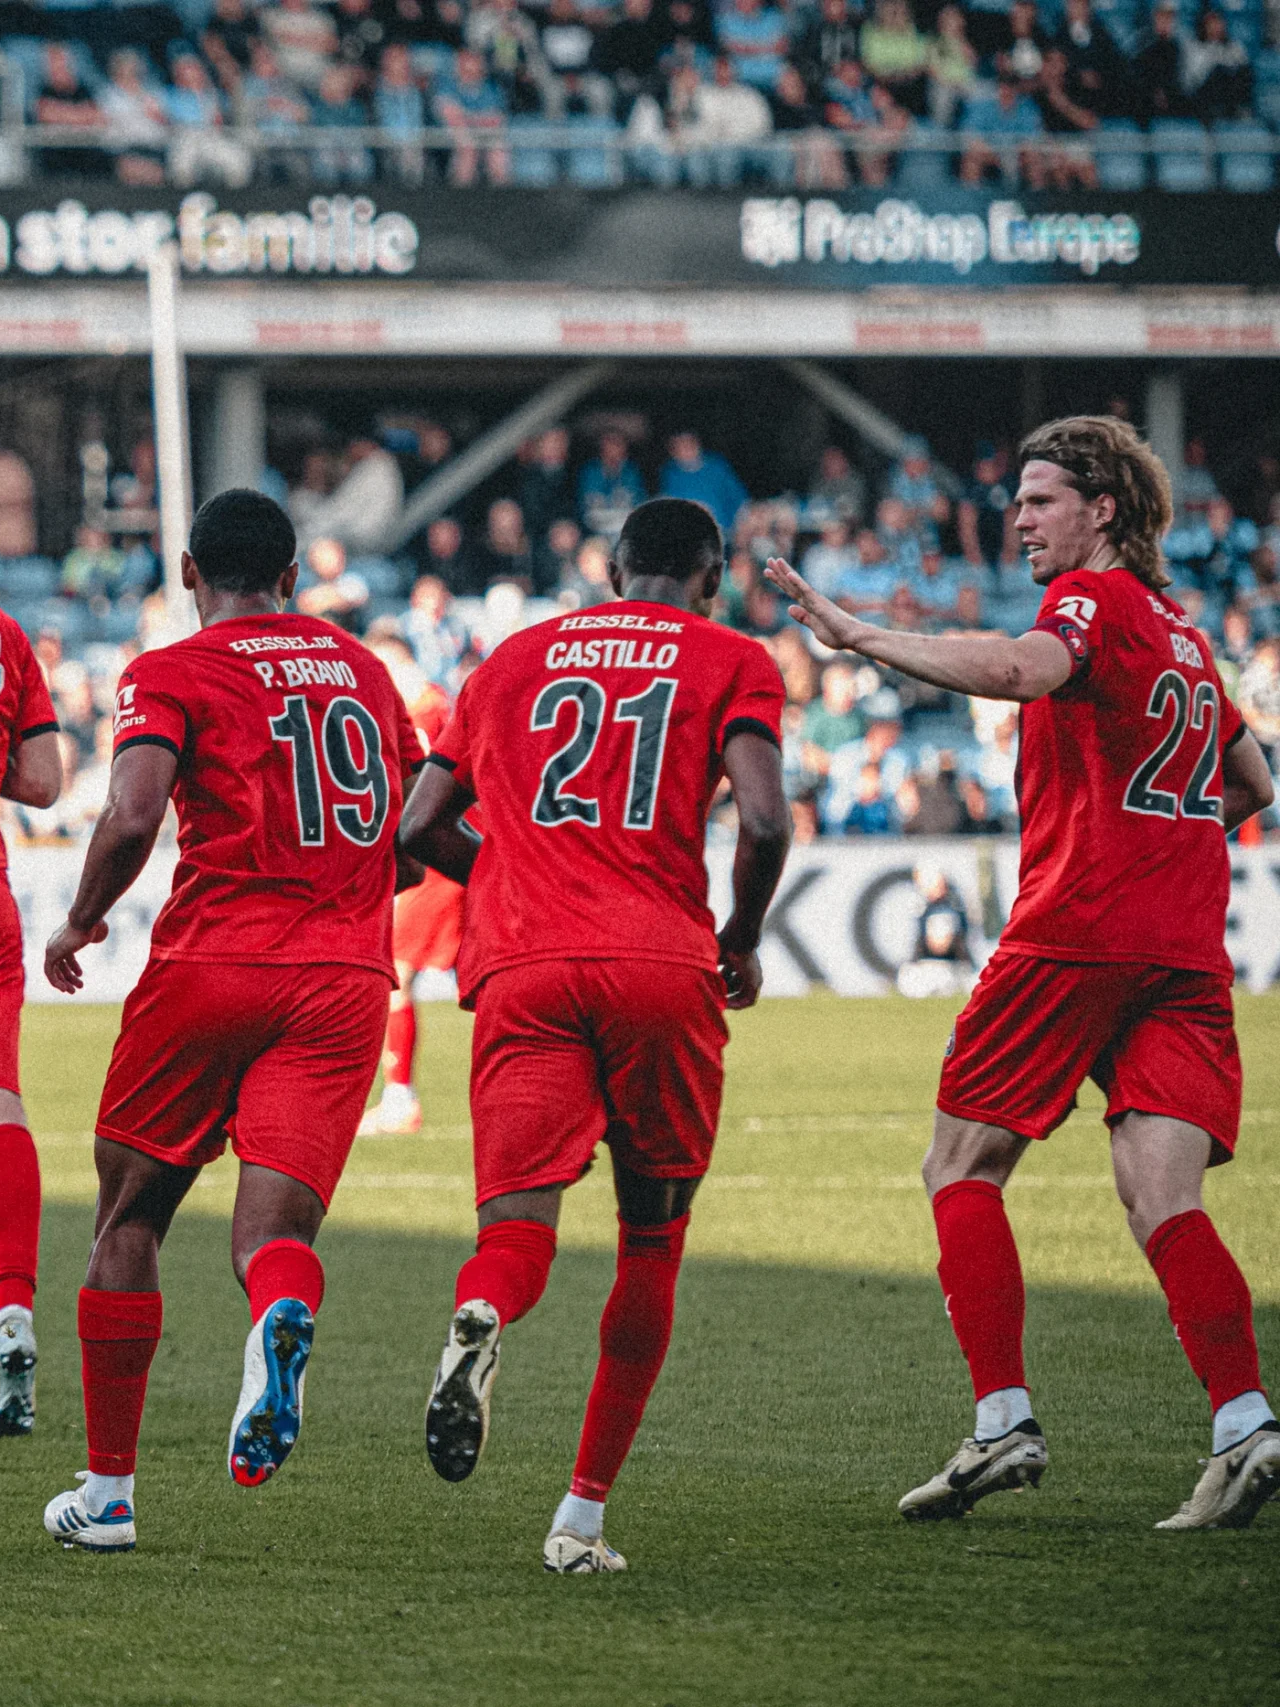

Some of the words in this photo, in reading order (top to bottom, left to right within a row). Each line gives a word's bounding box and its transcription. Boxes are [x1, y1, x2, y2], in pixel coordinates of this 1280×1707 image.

[178, 191, 419, 274] familie
[229, 635, 340, 655] HESSEL.DK
[558, 614, 686, 634] HESSEL.DK
[254, 661, 283, 689] P.
[279, 657, 359, 690] BRAVO
[545, 638, 680, 670] CASTILLO
[267, 694, 391, 848] 19
[529, 675, 680, 831] 21
[1121, 668, 1226, 827] 22
